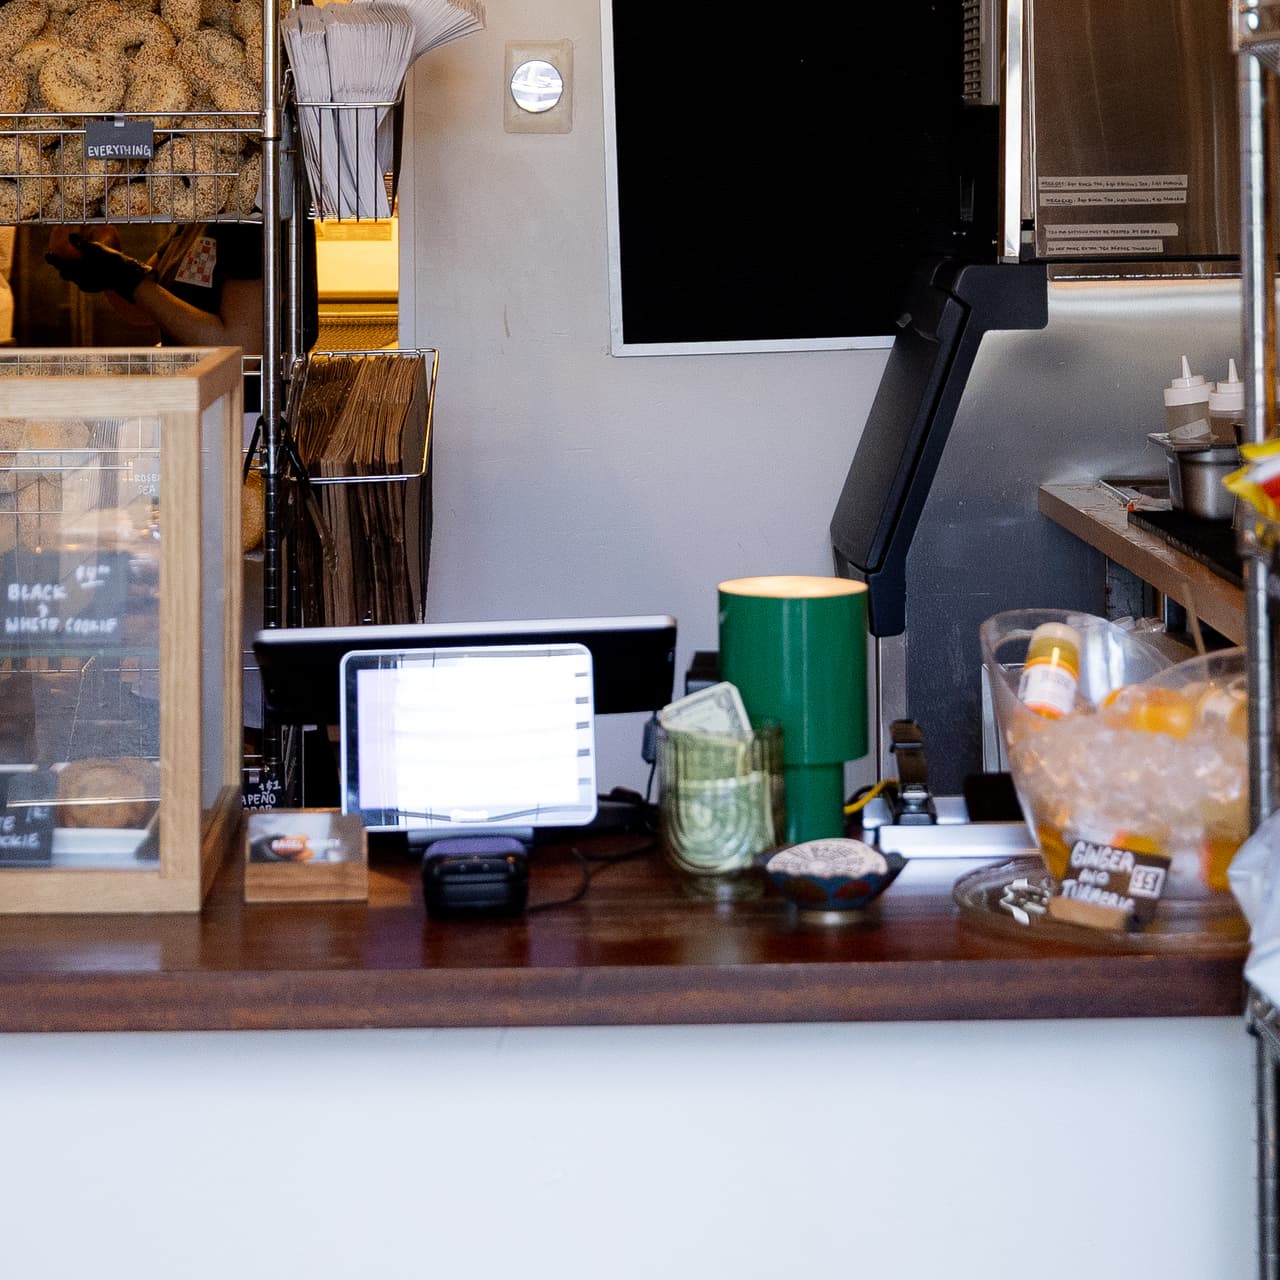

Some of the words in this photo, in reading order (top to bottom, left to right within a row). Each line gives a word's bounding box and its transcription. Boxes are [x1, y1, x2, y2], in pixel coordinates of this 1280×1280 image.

[88, 143, 151, 158] EVERYTHING
[7, 583, 67, 602] BLACK
[1070, 840, 1135, 873] GINGER
